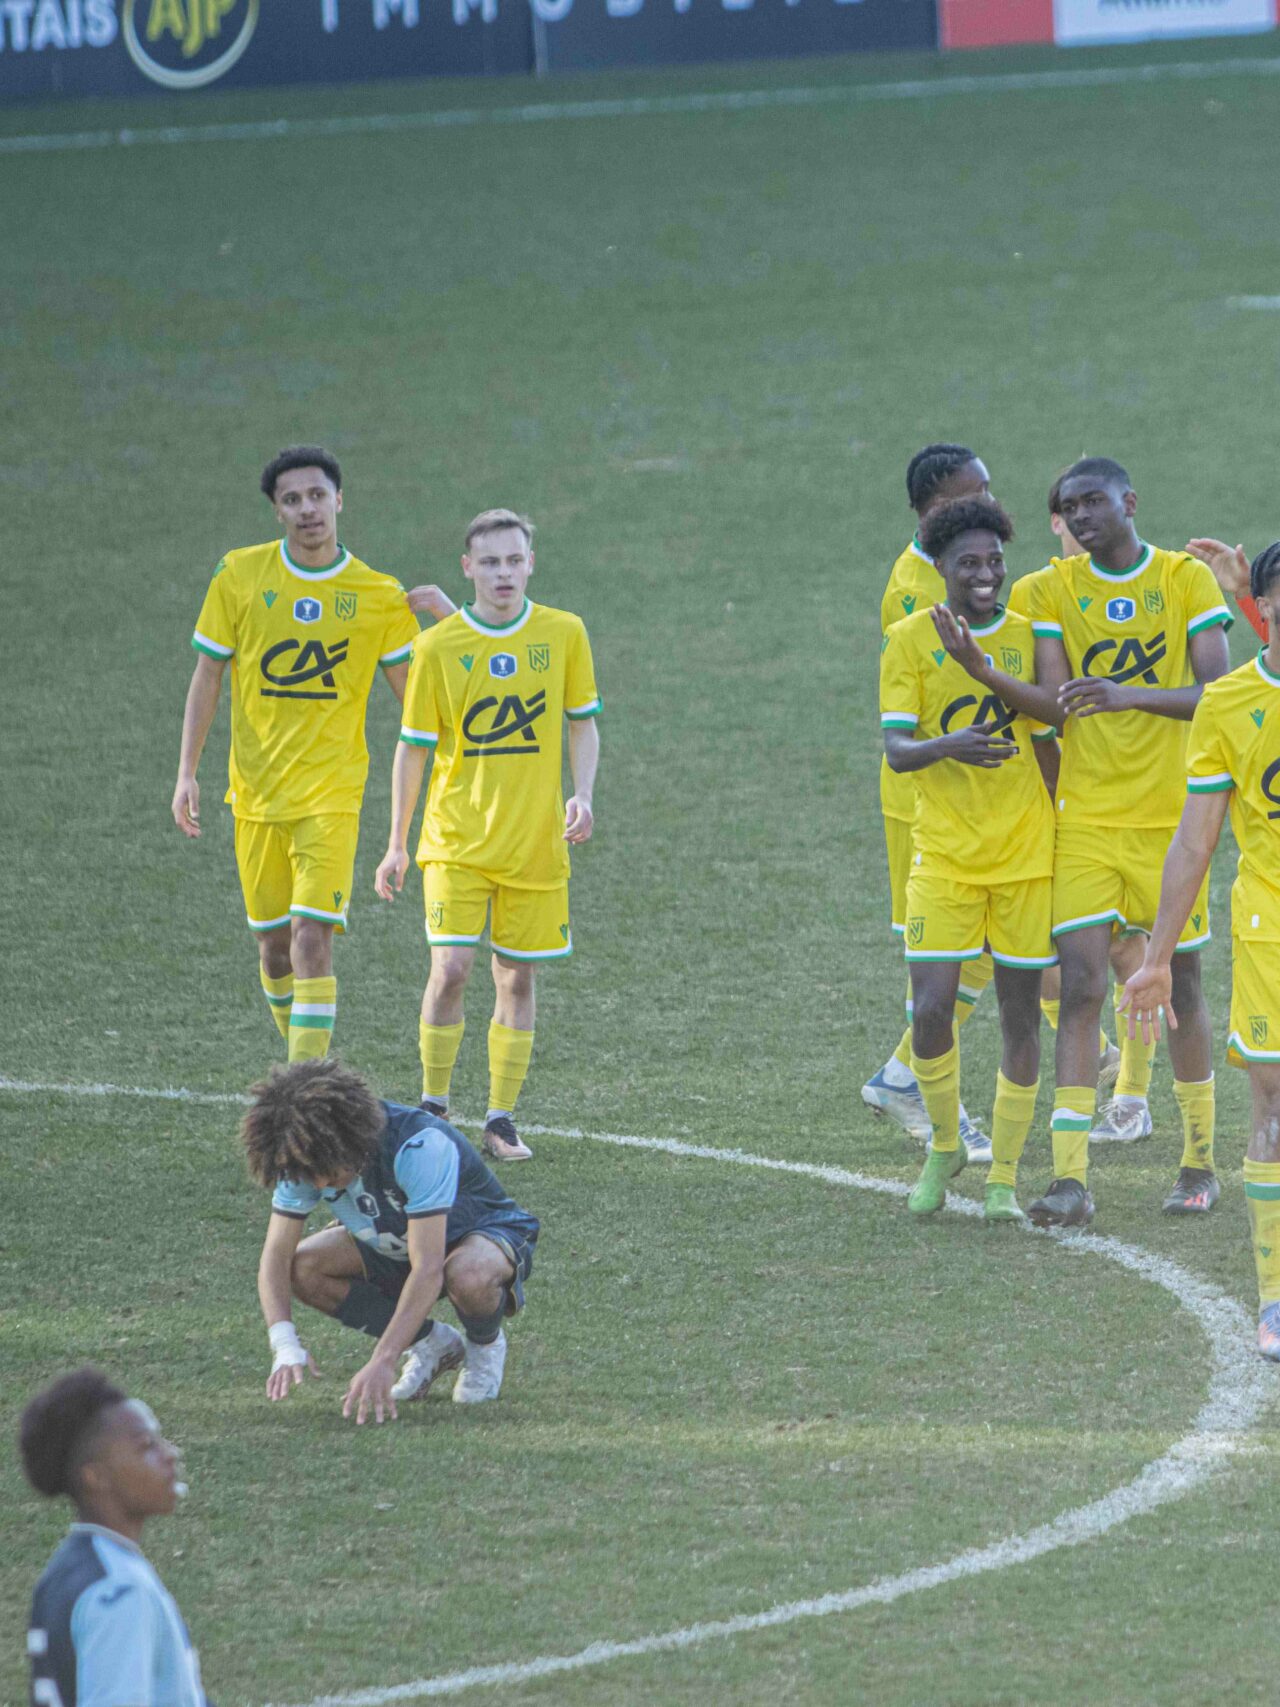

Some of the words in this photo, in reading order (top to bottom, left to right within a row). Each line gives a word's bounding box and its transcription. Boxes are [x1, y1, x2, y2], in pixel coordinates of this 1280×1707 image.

[0, 0, 118, 51] TAIS
[260, 638, 349, 687] CA
[1081, 630, 1166, 684] CA
[462, 689, 546, 742] CA
